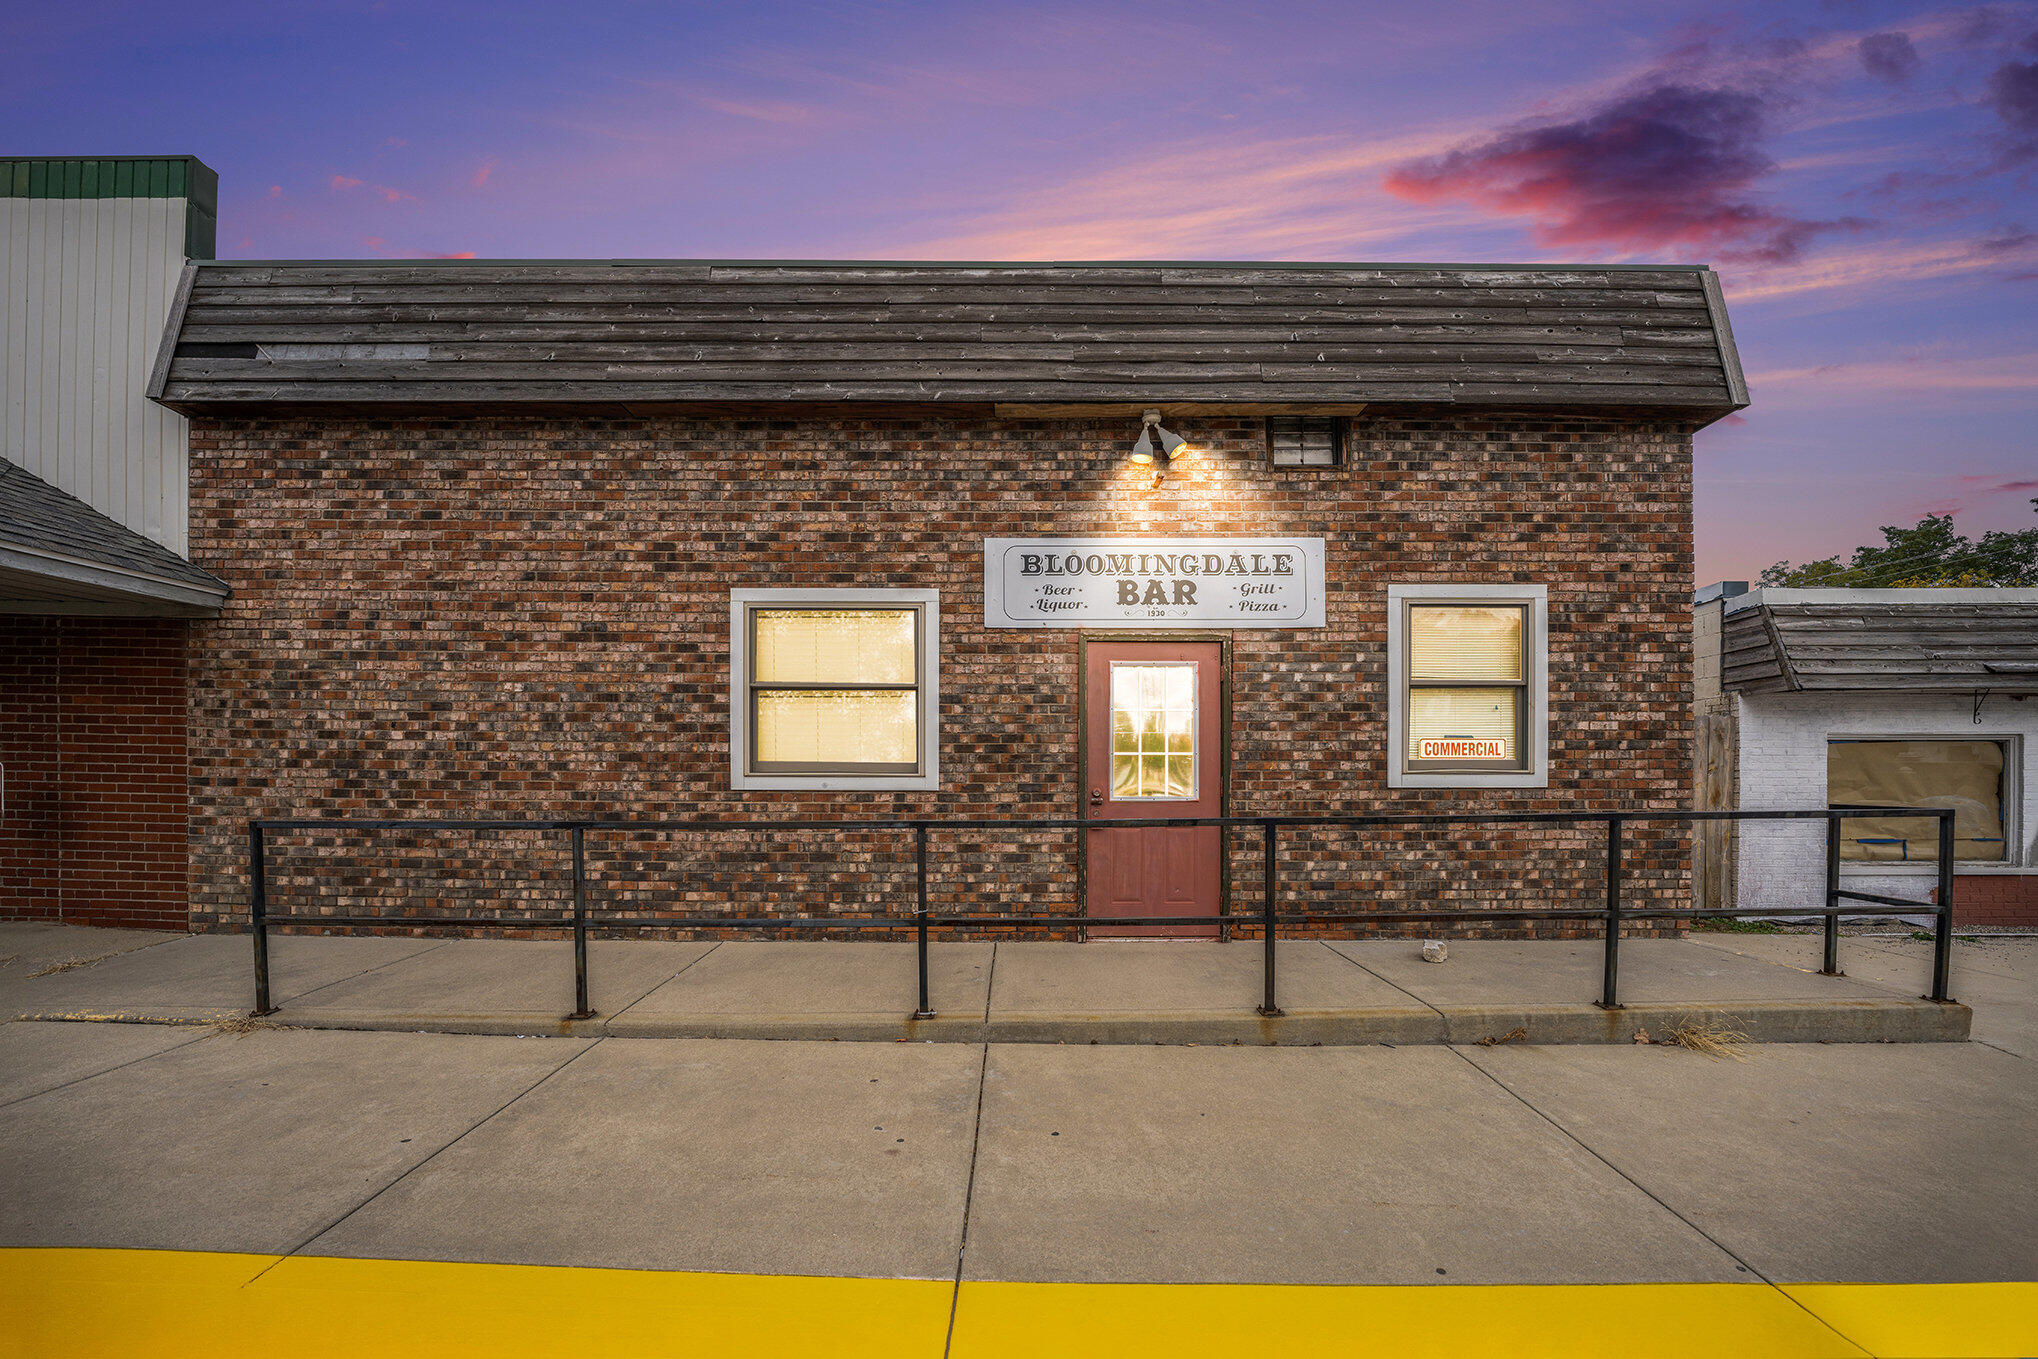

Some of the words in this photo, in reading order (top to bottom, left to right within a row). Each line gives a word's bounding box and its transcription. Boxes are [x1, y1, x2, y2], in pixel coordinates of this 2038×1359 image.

[1020, 553, 1294, 576] BLOOMINGDALE
[1042, 583, 1075, 596] Beer
[1115, 579, 1199, 606] BAR
[1240, 582, 1276, 596] Grill
[1035, 598, 1084, 612] Liquor
[1238, 600, 1281, 612] Pizza
[1424, 742, 1501, 756] COMMERCIAL
